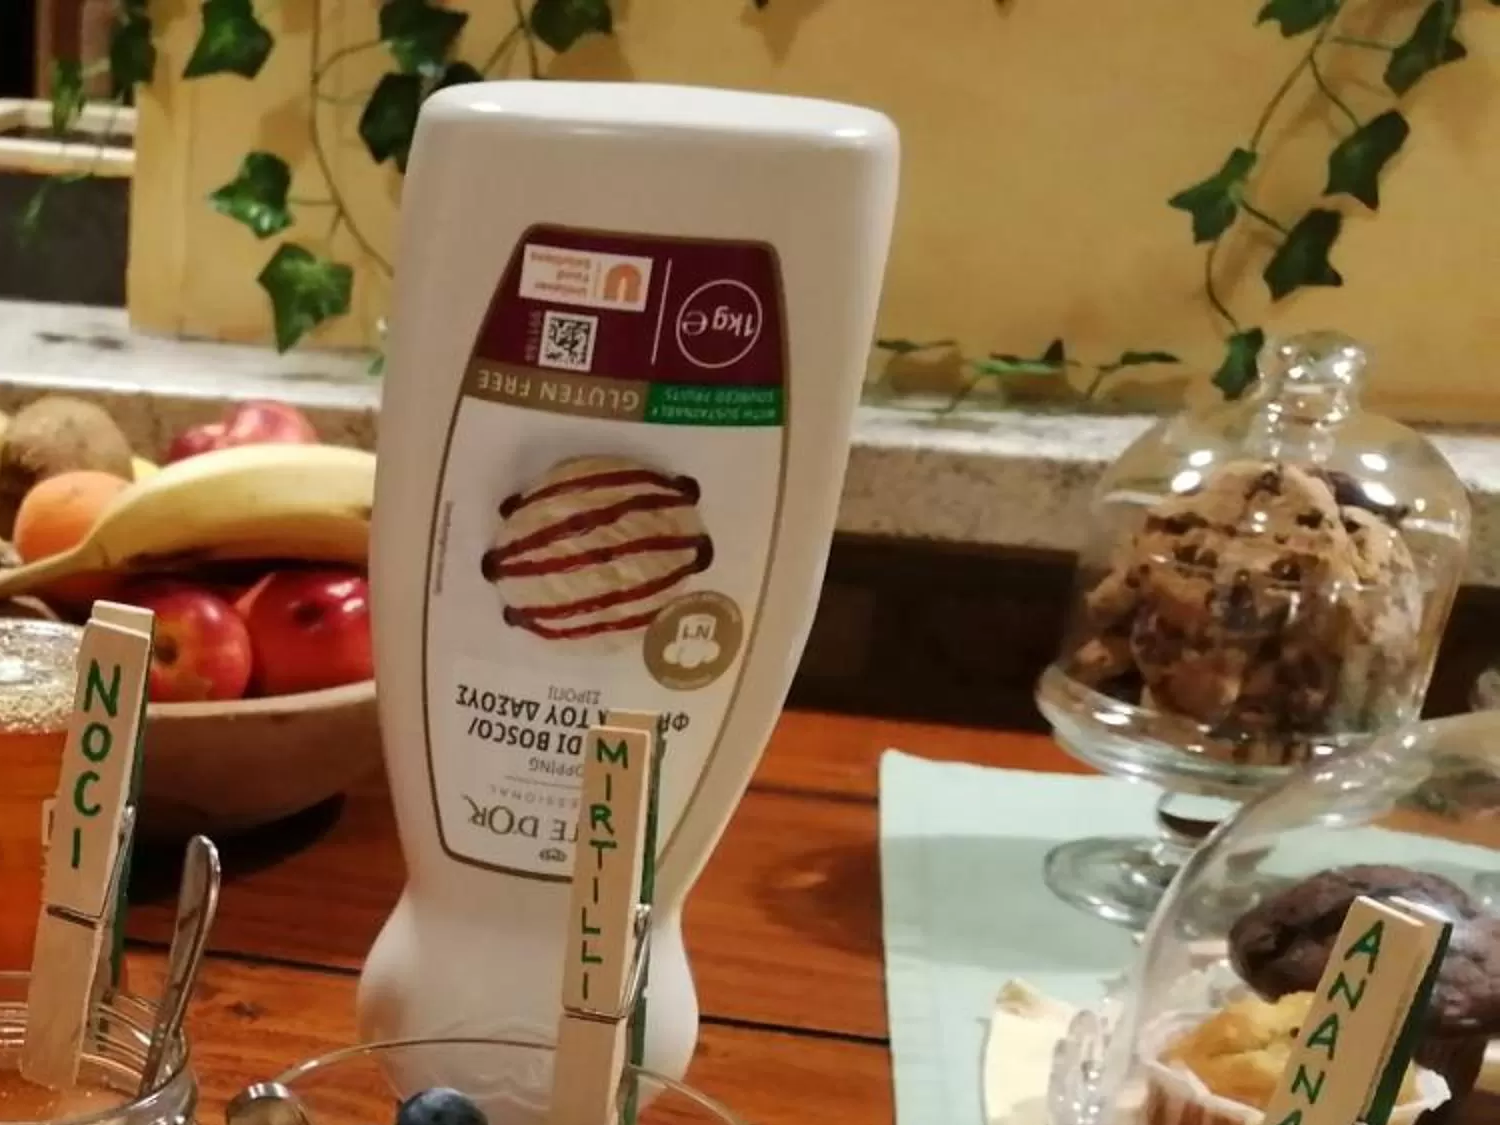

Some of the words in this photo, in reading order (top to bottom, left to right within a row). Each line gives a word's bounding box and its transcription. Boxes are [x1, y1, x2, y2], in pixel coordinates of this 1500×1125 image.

[714, 305, 754, 338] 1kg
[478, 369, 532, 396] FREE
[540, 382, 640, 411] GLUTEN
[556, 735, 582, 756] DI
[71, 659, 121, 869] NOCI
[581, 738, 629, 1000] MIRTILLI
